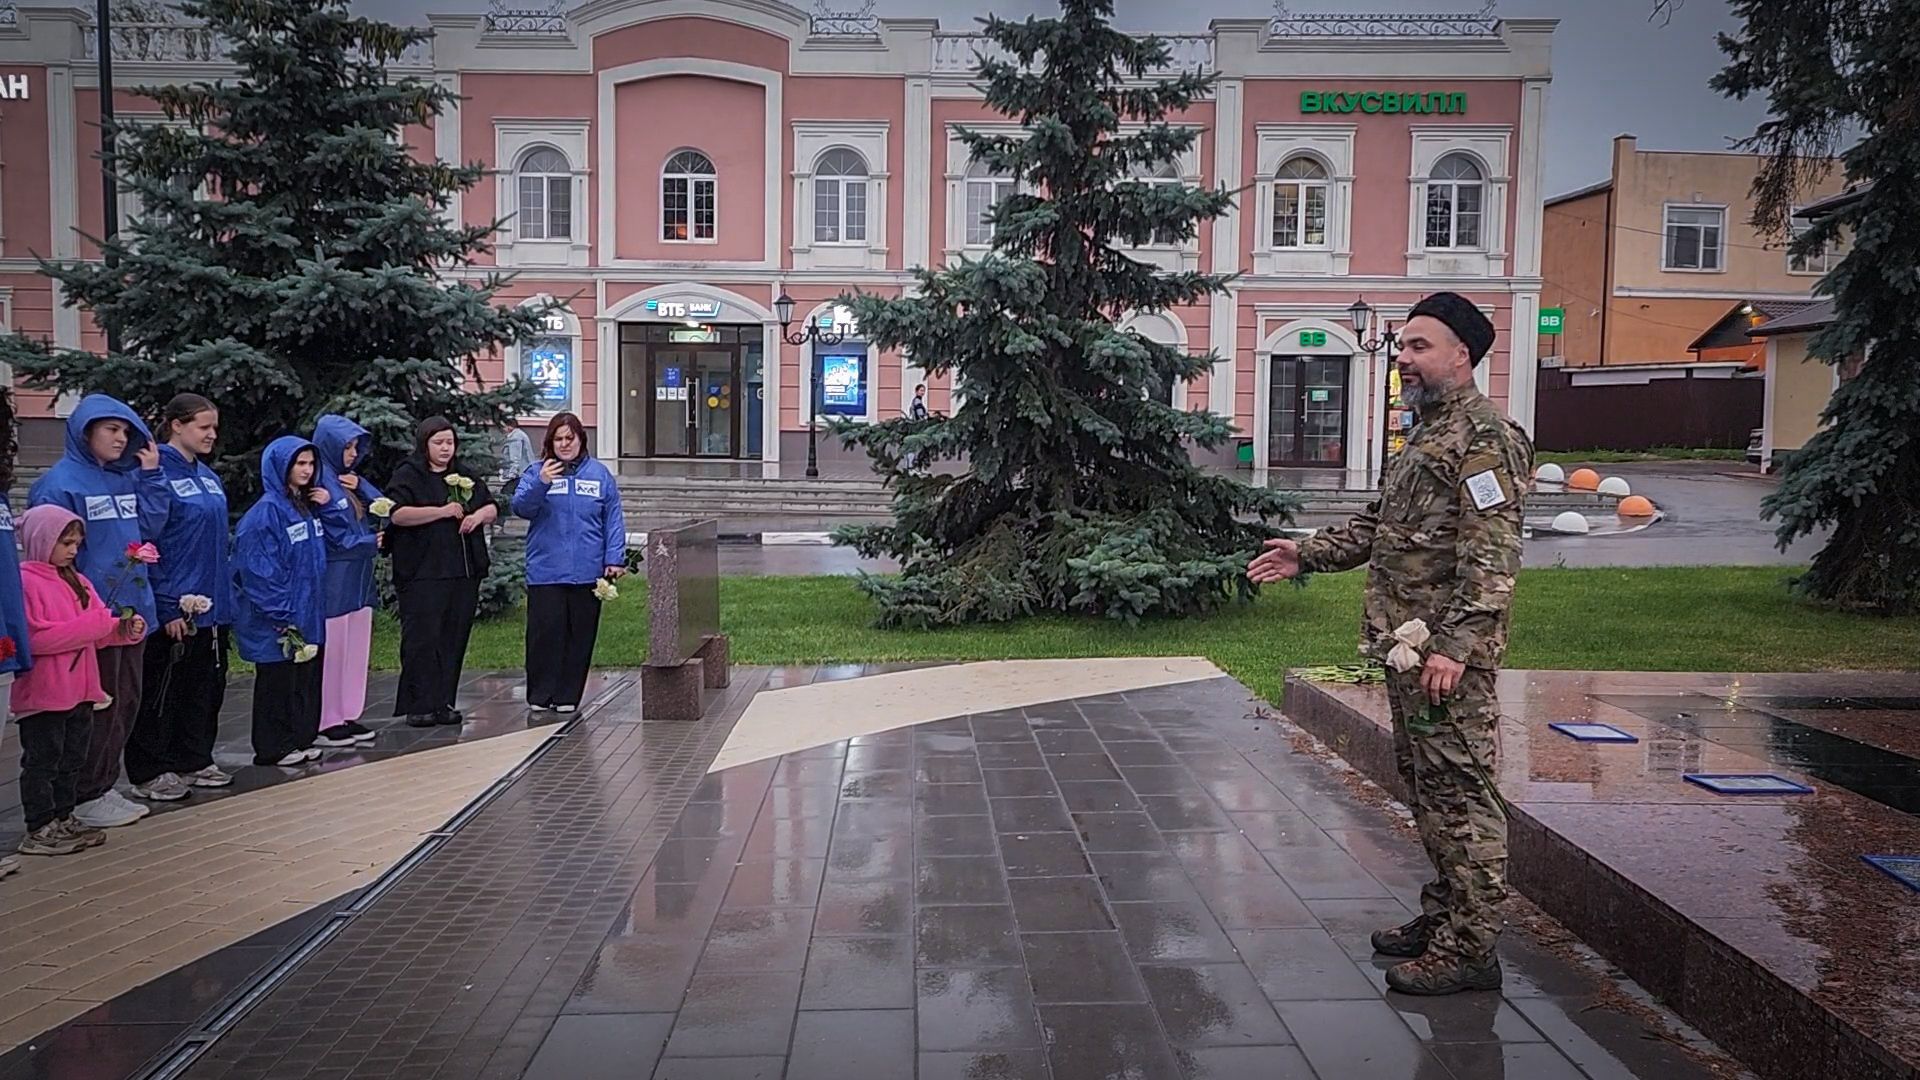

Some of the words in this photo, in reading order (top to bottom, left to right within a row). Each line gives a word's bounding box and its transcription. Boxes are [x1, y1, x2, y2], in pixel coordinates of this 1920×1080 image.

[1300, 91, 1467, 114] ВКУСВИЛЛ
[657, 302, 686, 317] ВТБ
[689, 303, 712, 312] БАНК
[537, 316, 564, 330] ТБ
[1541, 316, 1560, 326] ВВ
[1300, 331, 1326, 346] ВВ
